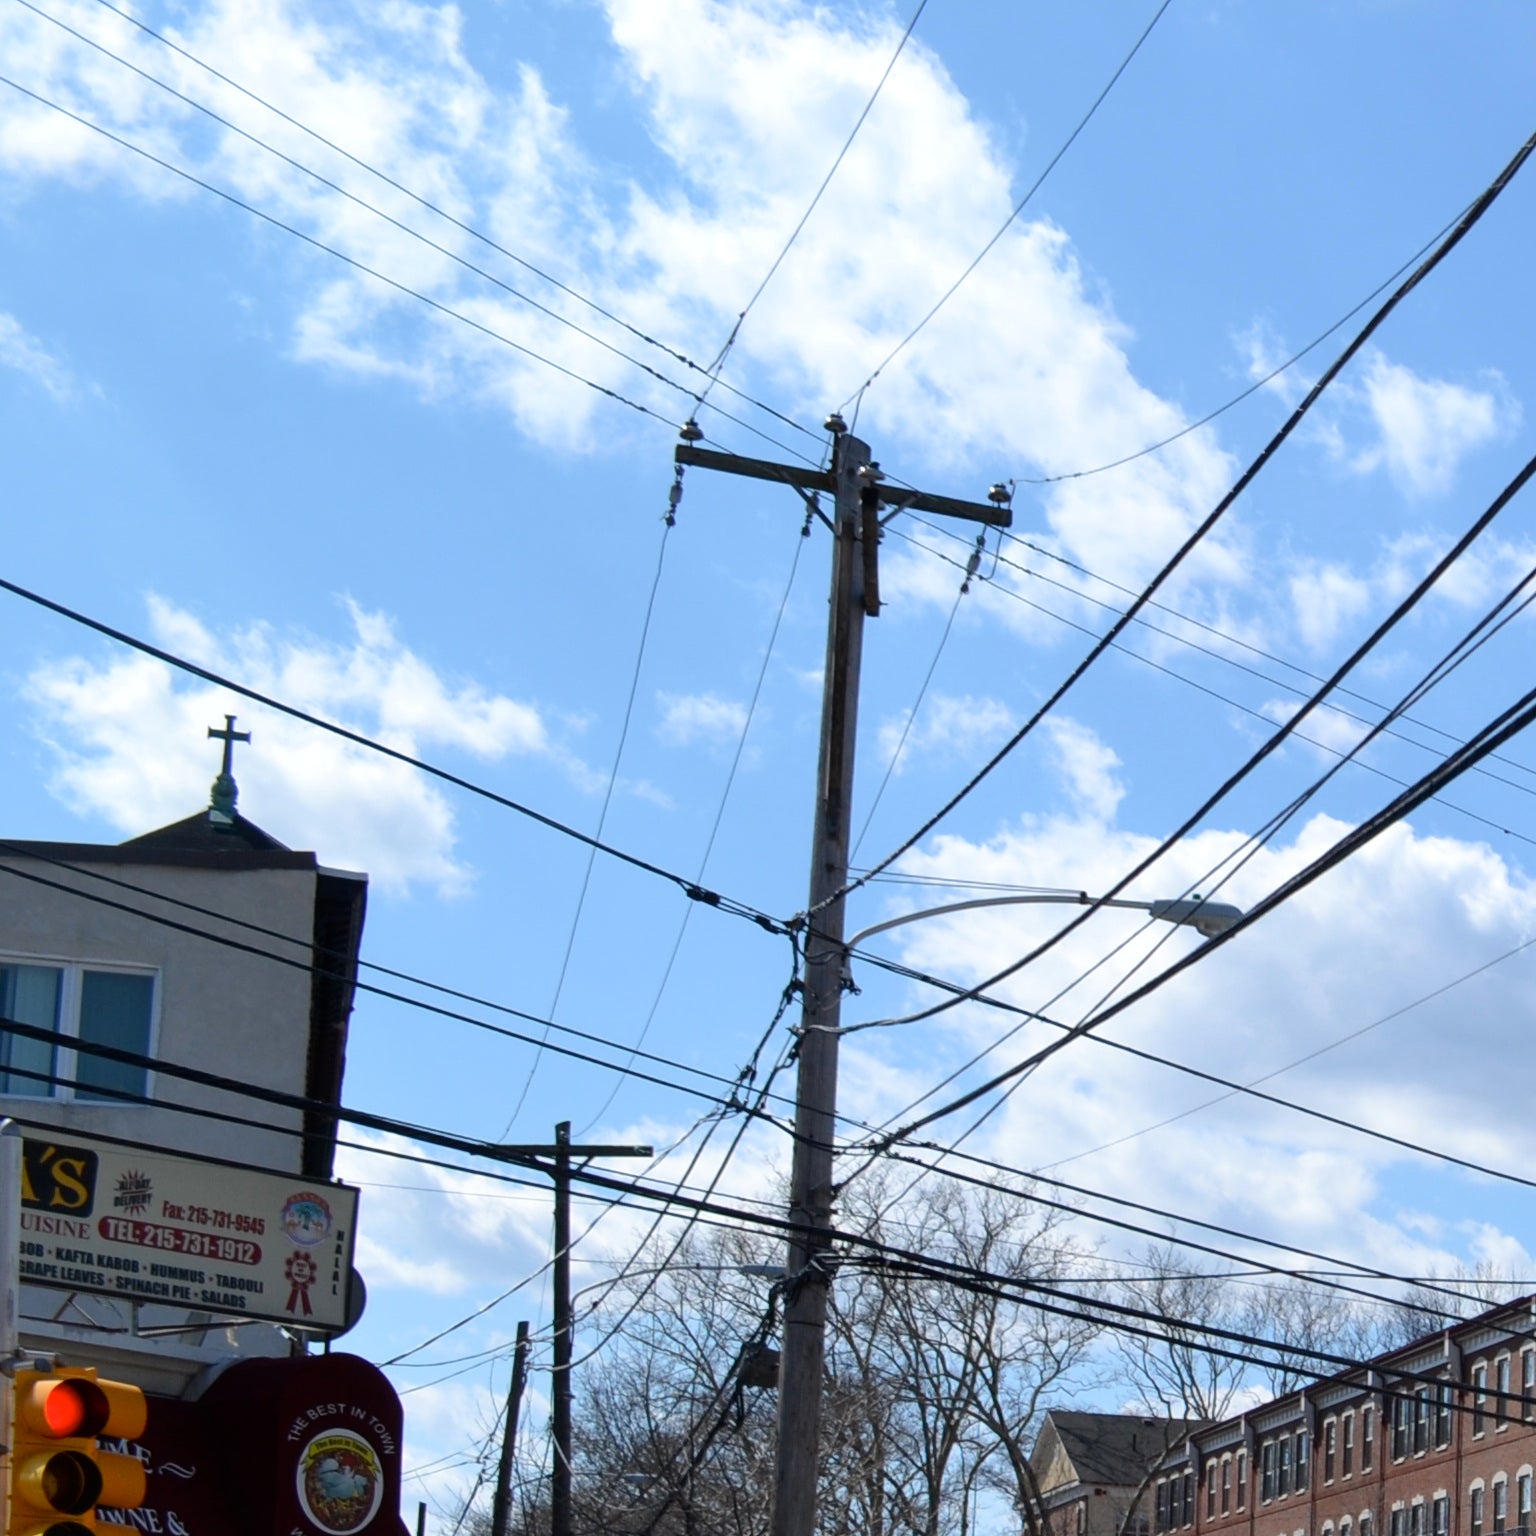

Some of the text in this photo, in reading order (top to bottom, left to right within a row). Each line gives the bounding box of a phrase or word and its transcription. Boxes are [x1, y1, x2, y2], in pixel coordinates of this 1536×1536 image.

[113, 1193, 153, 1208] DELIVERY
[162, 1200, 265, 1236] Fax: 215-731-9545
[107, 1219, 255, 1264] TEL: 215-731-1912
[332, 1230, 345, 1296] HALAL
[56, 1247, 95, 1266] KAFTA
[97, 1253, 140, 1274] KABOB
[151, 1263, 206, 1285] HUMMUS
[216, 1274, 264, 1294] TABOULI
[61, 1266, 105, 1286] LEAVES
[115, 1275, 170, 1296] SPINACH
[172, 1284, 192, 1300] PIE
[201, 1289, 247, 1309] SALADS
[288, 1403, 395, 1456] THE BEST IN TOWN
[167, 1511, 190, 1536] &
